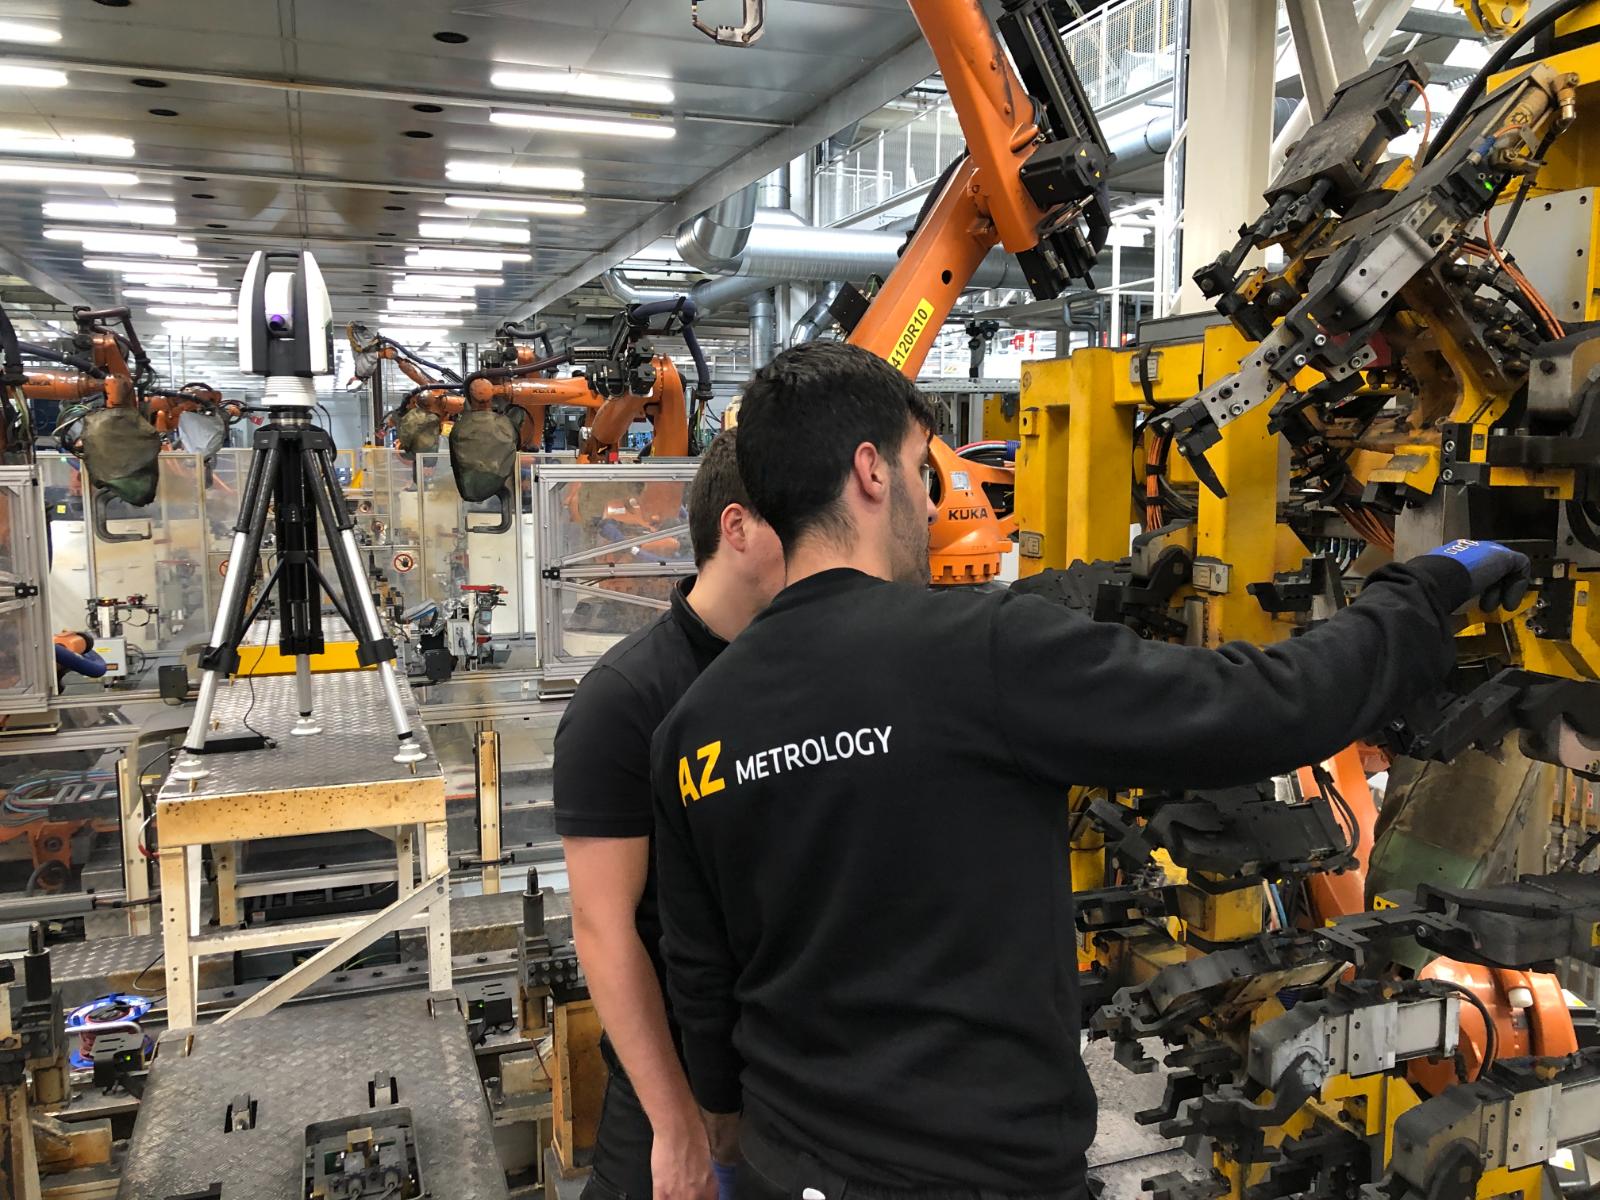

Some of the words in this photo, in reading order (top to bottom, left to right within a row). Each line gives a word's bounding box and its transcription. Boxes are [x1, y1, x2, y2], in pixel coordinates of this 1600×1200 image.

[891, 308, 928, 368] 4120R10
[948, 508, 988, 521] KUKA
[678, 740, 726, 808] AZ
[735, 725, 892, 785] METROLOGY
